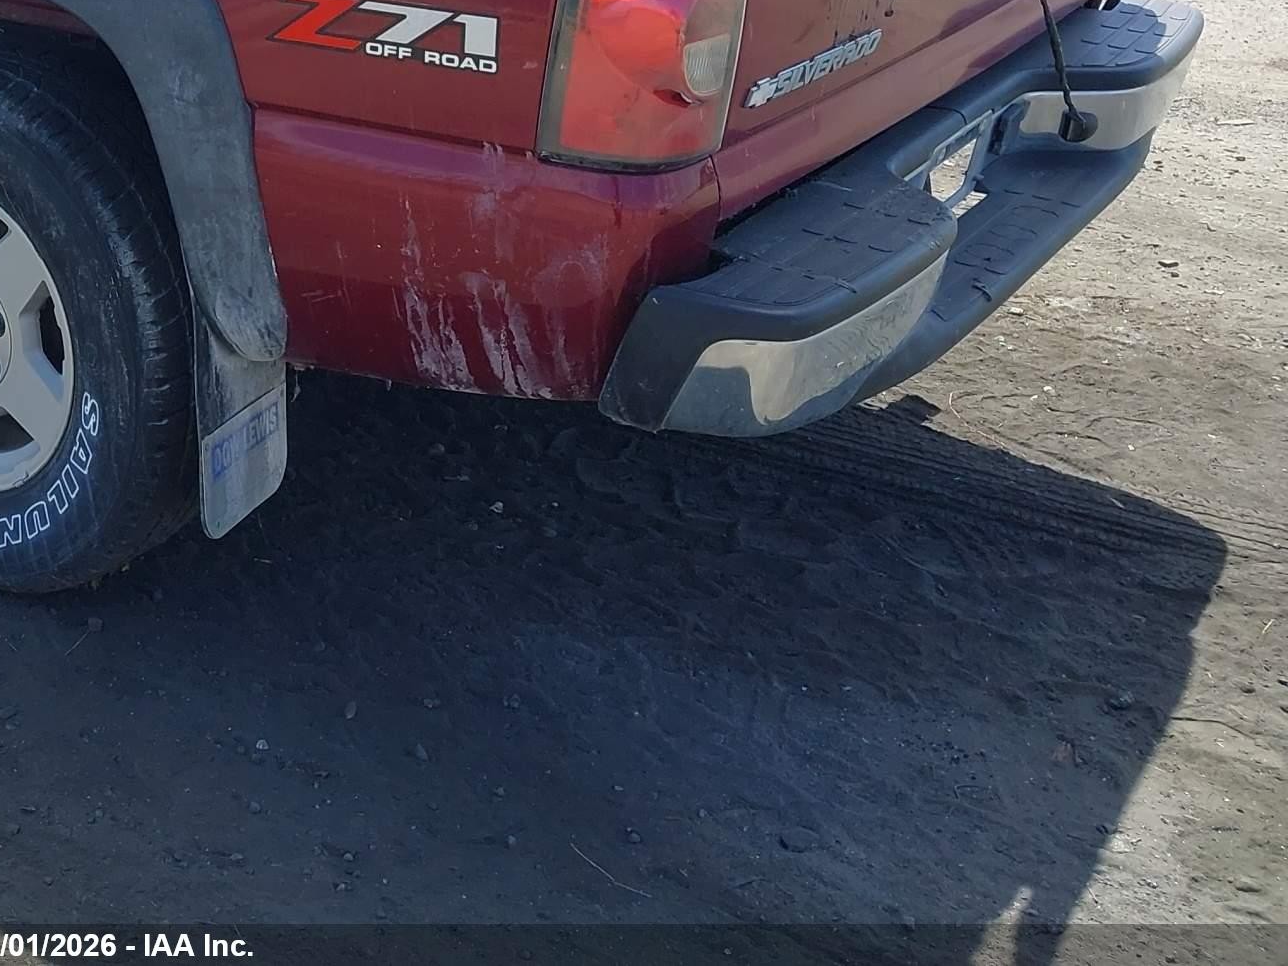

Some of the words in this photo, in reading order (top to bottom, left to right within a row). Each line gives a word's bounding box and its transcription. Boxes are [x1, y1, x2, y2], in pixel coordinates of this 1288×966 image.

[365, 41, 412, 60] OFF
[423, 49, 497, 74] ROAD
[774, 29, 883, 98] SILVERADO
